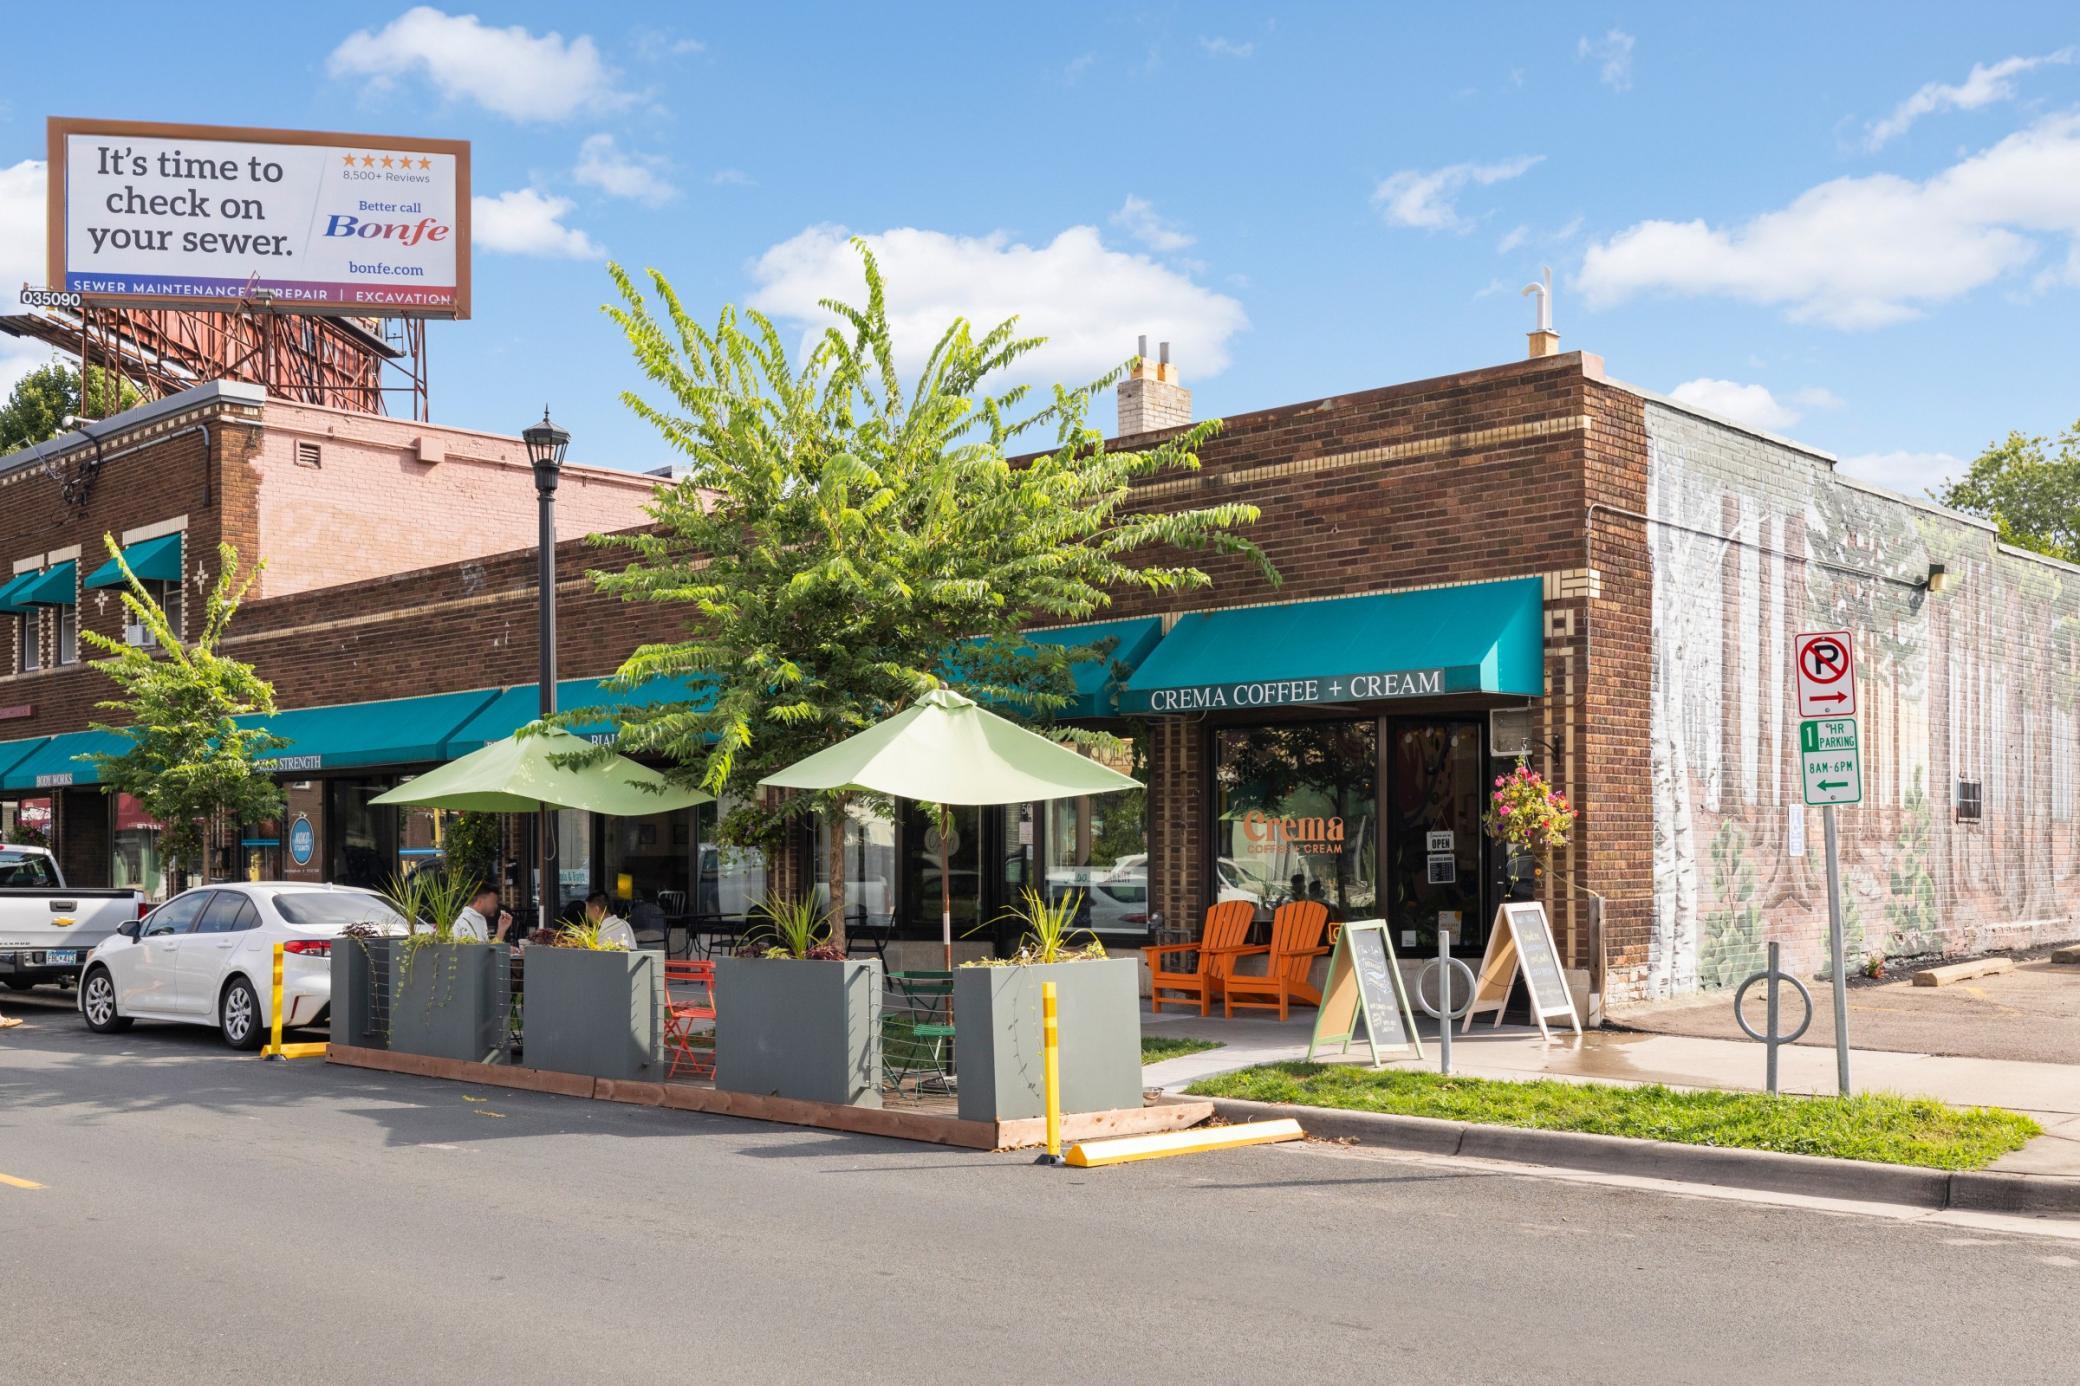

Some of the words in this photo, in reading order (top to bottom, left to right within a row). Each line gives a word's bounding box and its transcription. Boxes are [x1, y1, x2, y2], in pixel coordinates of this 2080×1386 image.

[97, 146, 148, 176] It’s
[157, 150, 239, 180] time
[247, 156, 284, 183] to
[343, 170, 381, 182] 8,500+
[386, 172, 430, 183] Reviews
[106, 185, 211, 218] check
[220, 198, 265, 220] on
[359, 200, 397, 212] Better
[400, 202, 421, 213] call
[87, 227, 173, 254] your
[183, 231, 293, 256] sewer.
[322, 214, 450, 247] Bonfe
[349, 261, 424, 276] bonfe.com
[21, 291, 81, 307] 035090
[73, 280, 126, 293] SEWER
[133, 283, 246, 297] MAINTENANCE
[275, 288, 328, 300] REPAIR
[356, 291, 450, 305] EXCAVATION
[1814, 644, 1839, 675] P
[1151, 687, 1228, 710] CREMA
[1233, 680, 1319, 705] COFFEE
[1350, 671, 1441, 698] CREAM
[1806, 726, 1813, 748] 1
[1830, 723, 1844, 734] HR
[1819, 735, 1855, 748] PARKING
[280, 755, 321, 770] STRENGTH
[1243, 809, 1345, 842] Crema
[1303, 844, 1343, 854] CREAM
[1431, 838, 1450, 849] OPEN
